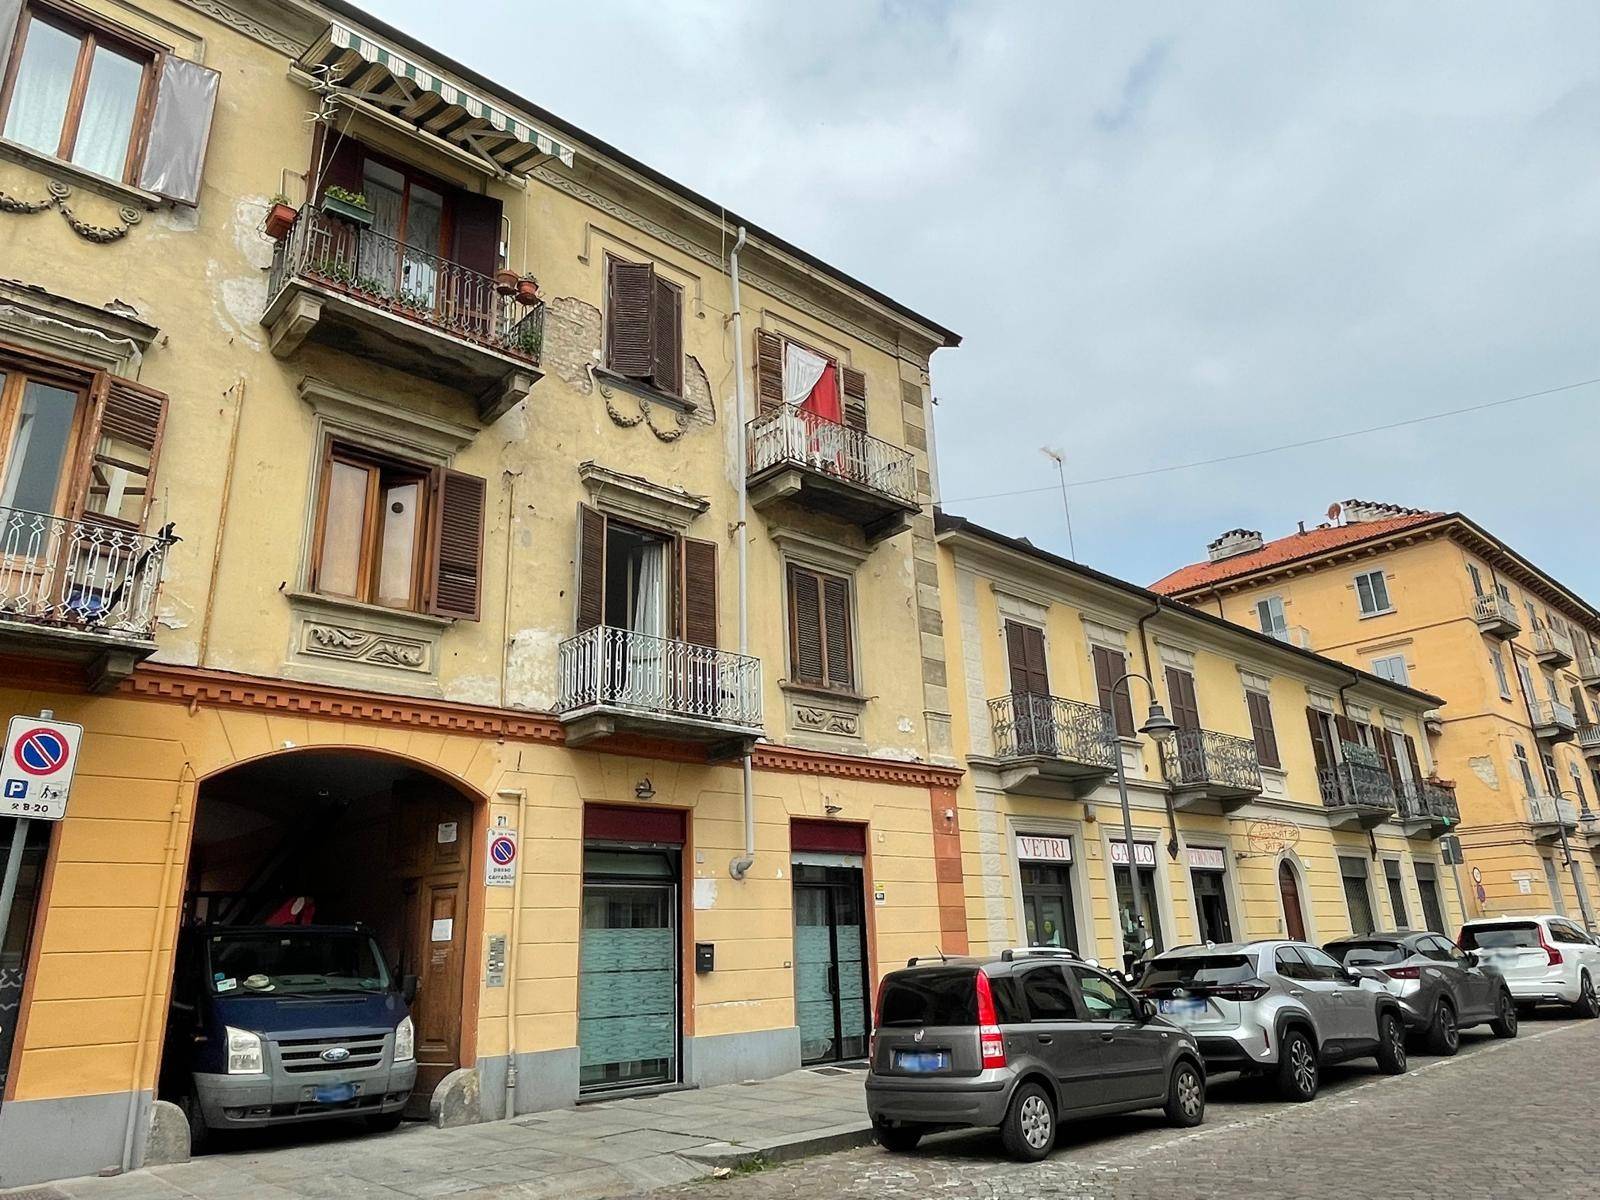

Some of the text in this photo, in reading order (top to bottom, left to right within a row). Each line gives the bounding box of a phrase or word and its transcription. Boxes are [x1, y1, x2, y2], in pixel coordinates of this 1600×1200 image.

[9, 782, 24, 796] P
[23, 803, 48, 812] 8-20
[497, 815, 507, 826] 71
[1021, 838, 1065, 857] VETRI
[1111, 843, 1152, 862] GALO
